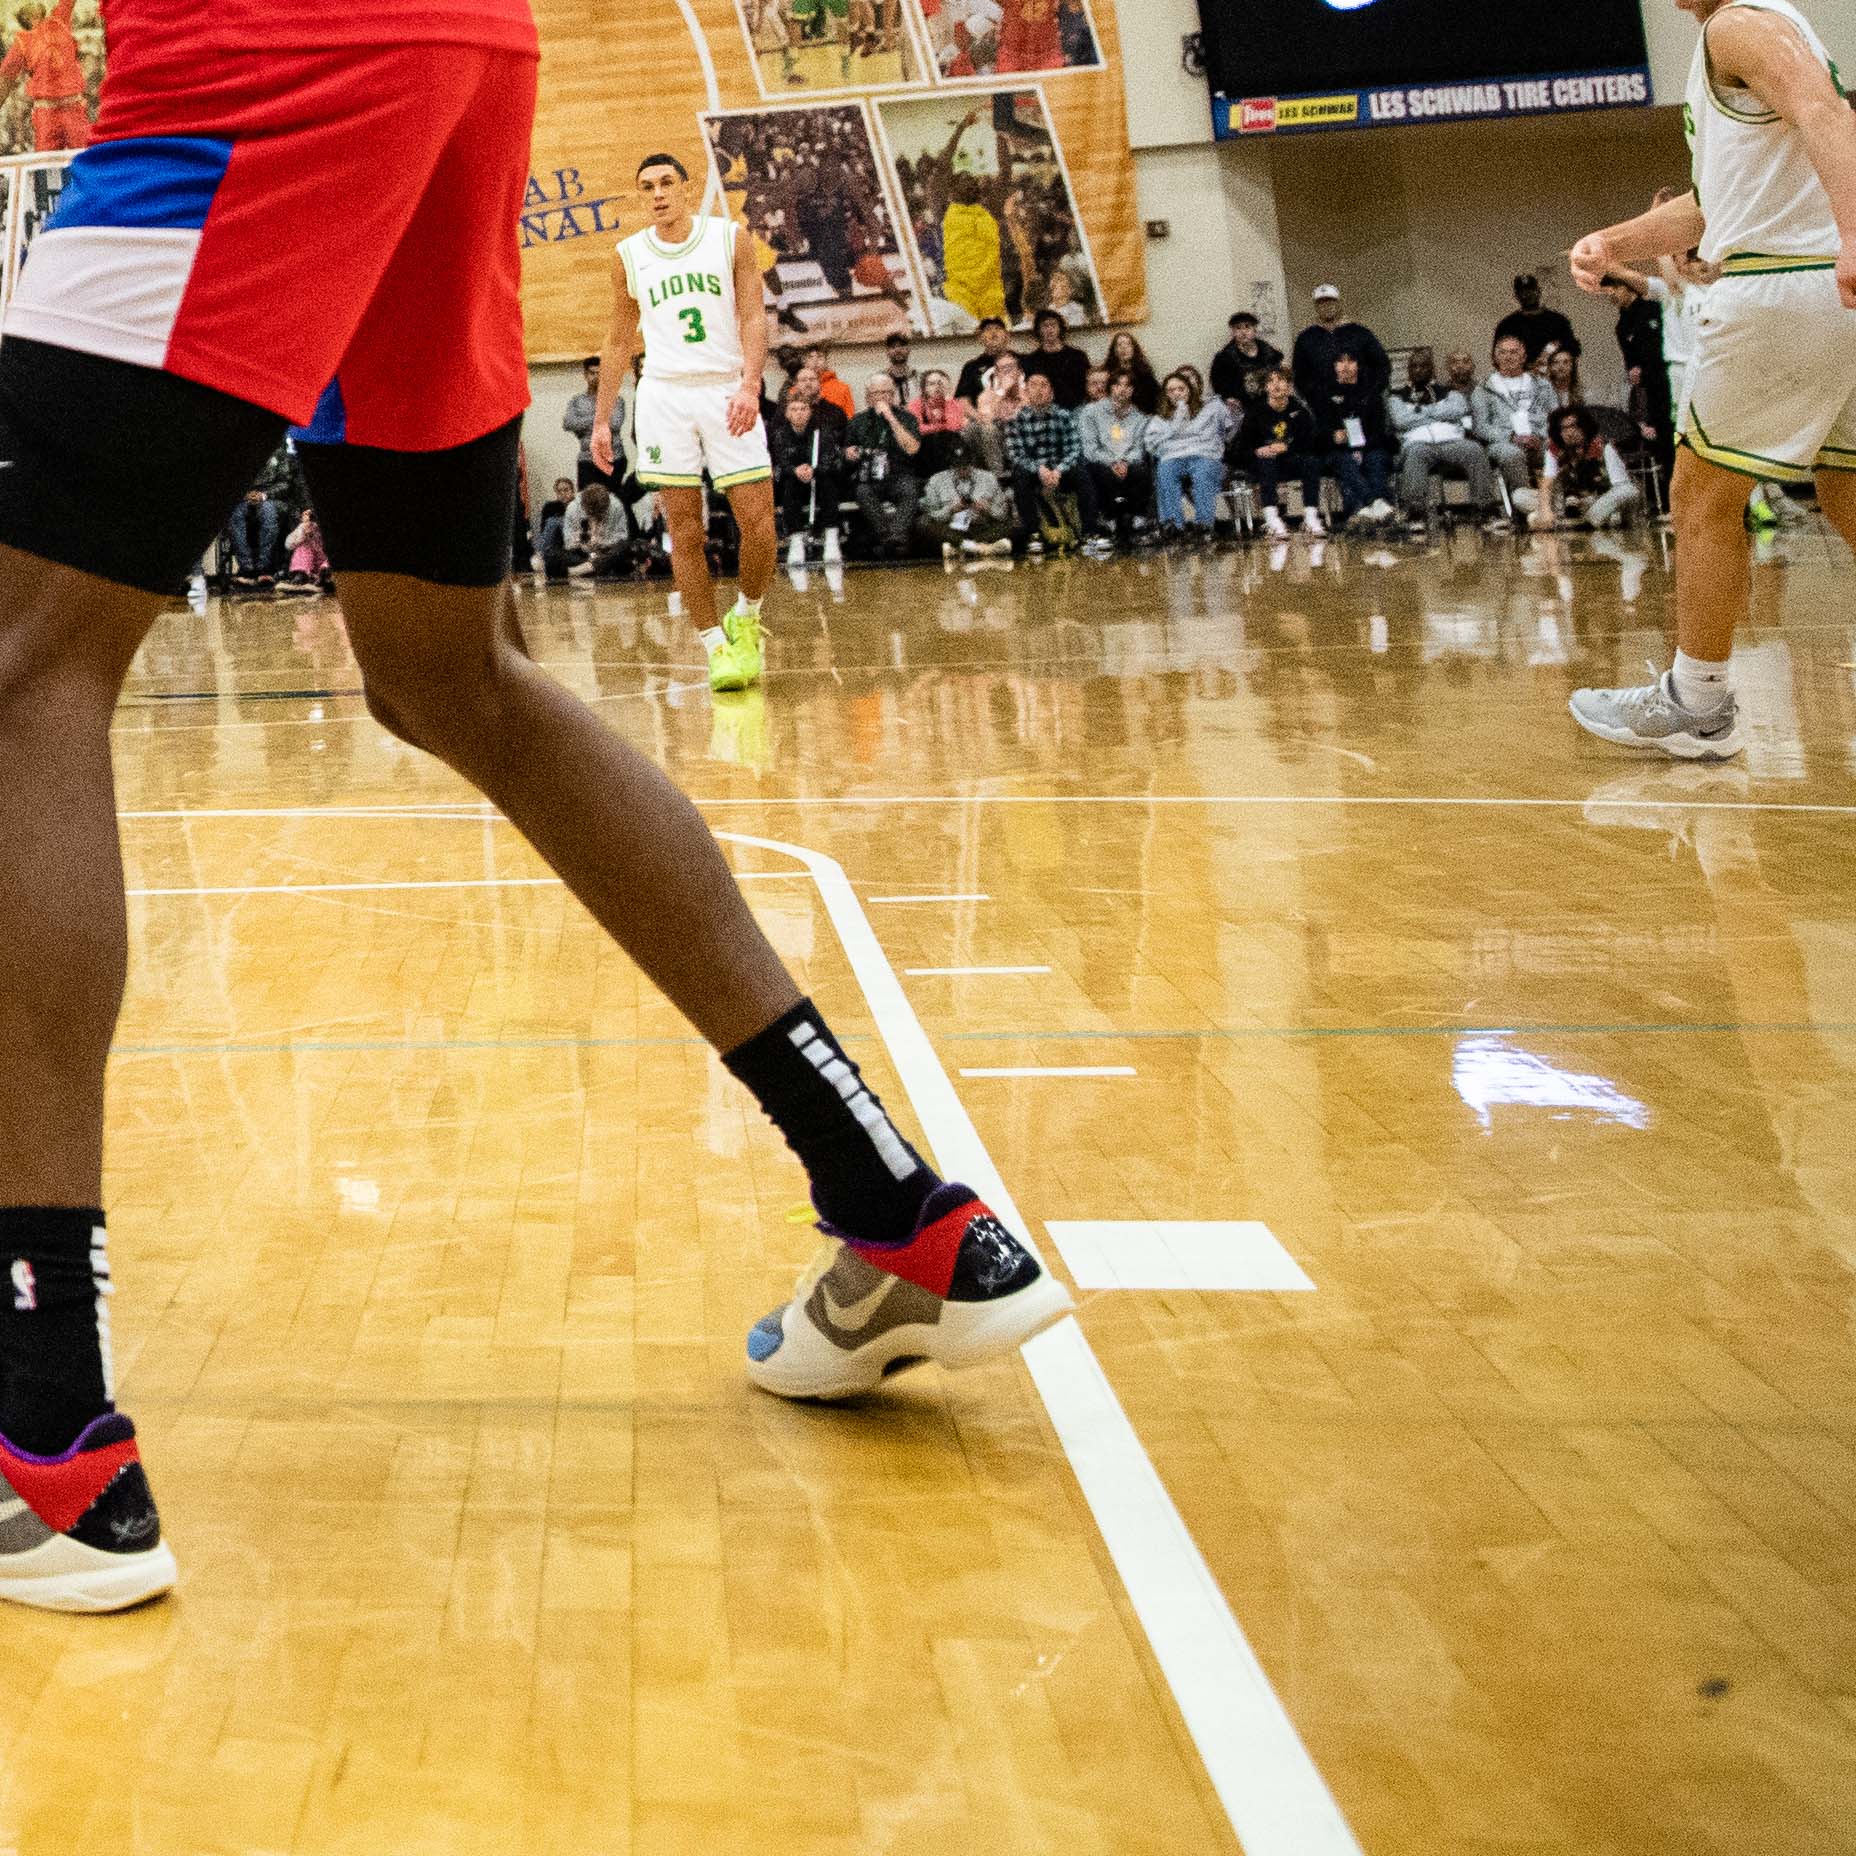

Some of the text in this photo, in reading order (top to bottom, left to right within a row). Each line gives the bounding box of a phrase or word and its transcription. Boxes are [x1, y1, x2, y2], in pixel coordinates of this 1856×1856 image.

[1369, 73, 1647, 120] LES SCHWAB TIRE CENTERS
[648, 272, 723, 308] LIONS
[678, 305, 708, 344] 3
